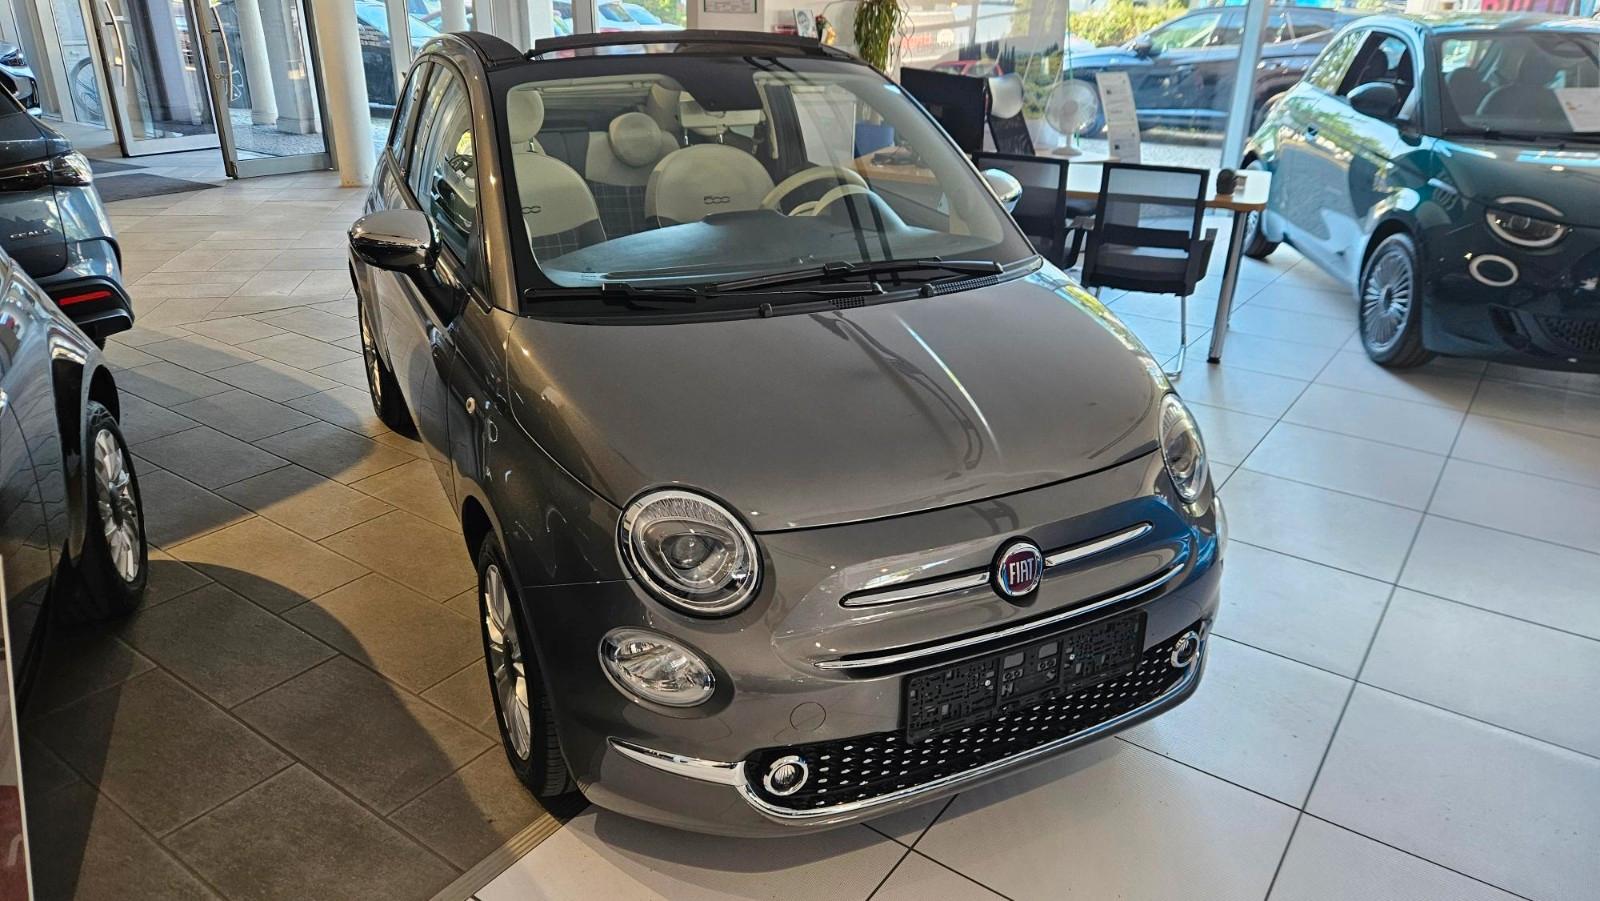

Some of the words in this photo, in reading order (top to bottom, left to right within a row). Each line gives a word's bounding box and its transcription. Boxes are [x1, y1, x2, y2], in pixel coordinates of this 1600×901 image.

[703, 195, 730, 205] 500
[520, 205, 541, 214] 00
[1009, 557, 1034, 585] FIAT
